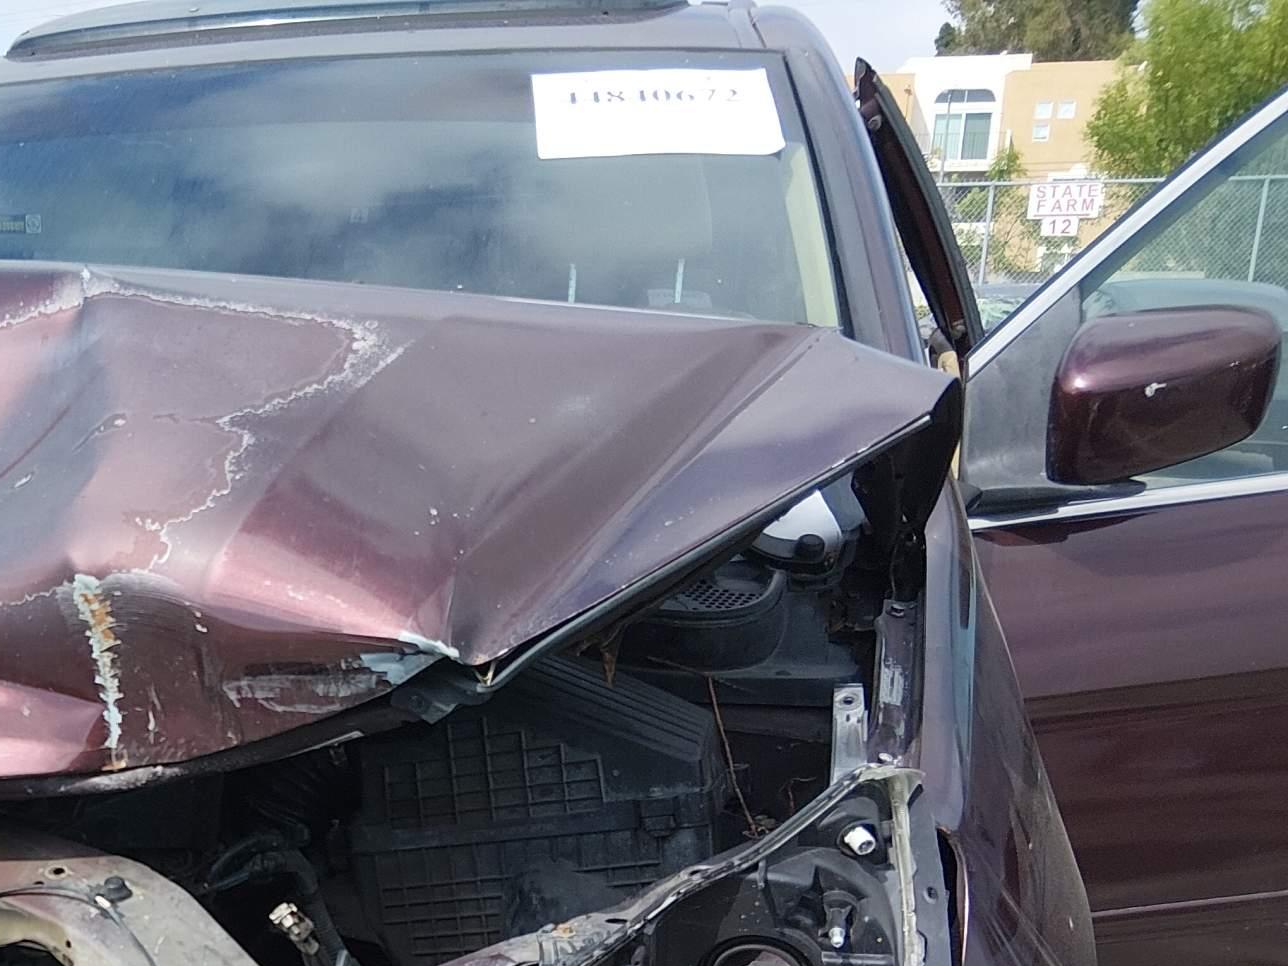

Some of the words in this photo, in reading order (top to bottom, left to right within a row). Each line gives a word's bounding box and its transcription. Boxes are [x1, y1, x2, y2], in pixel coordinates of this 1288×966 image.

[1036, 184, 1099, 199] STATE
[1036, 198, 1095, 213] FARM
[1049, 218, 1072, 235] 12
